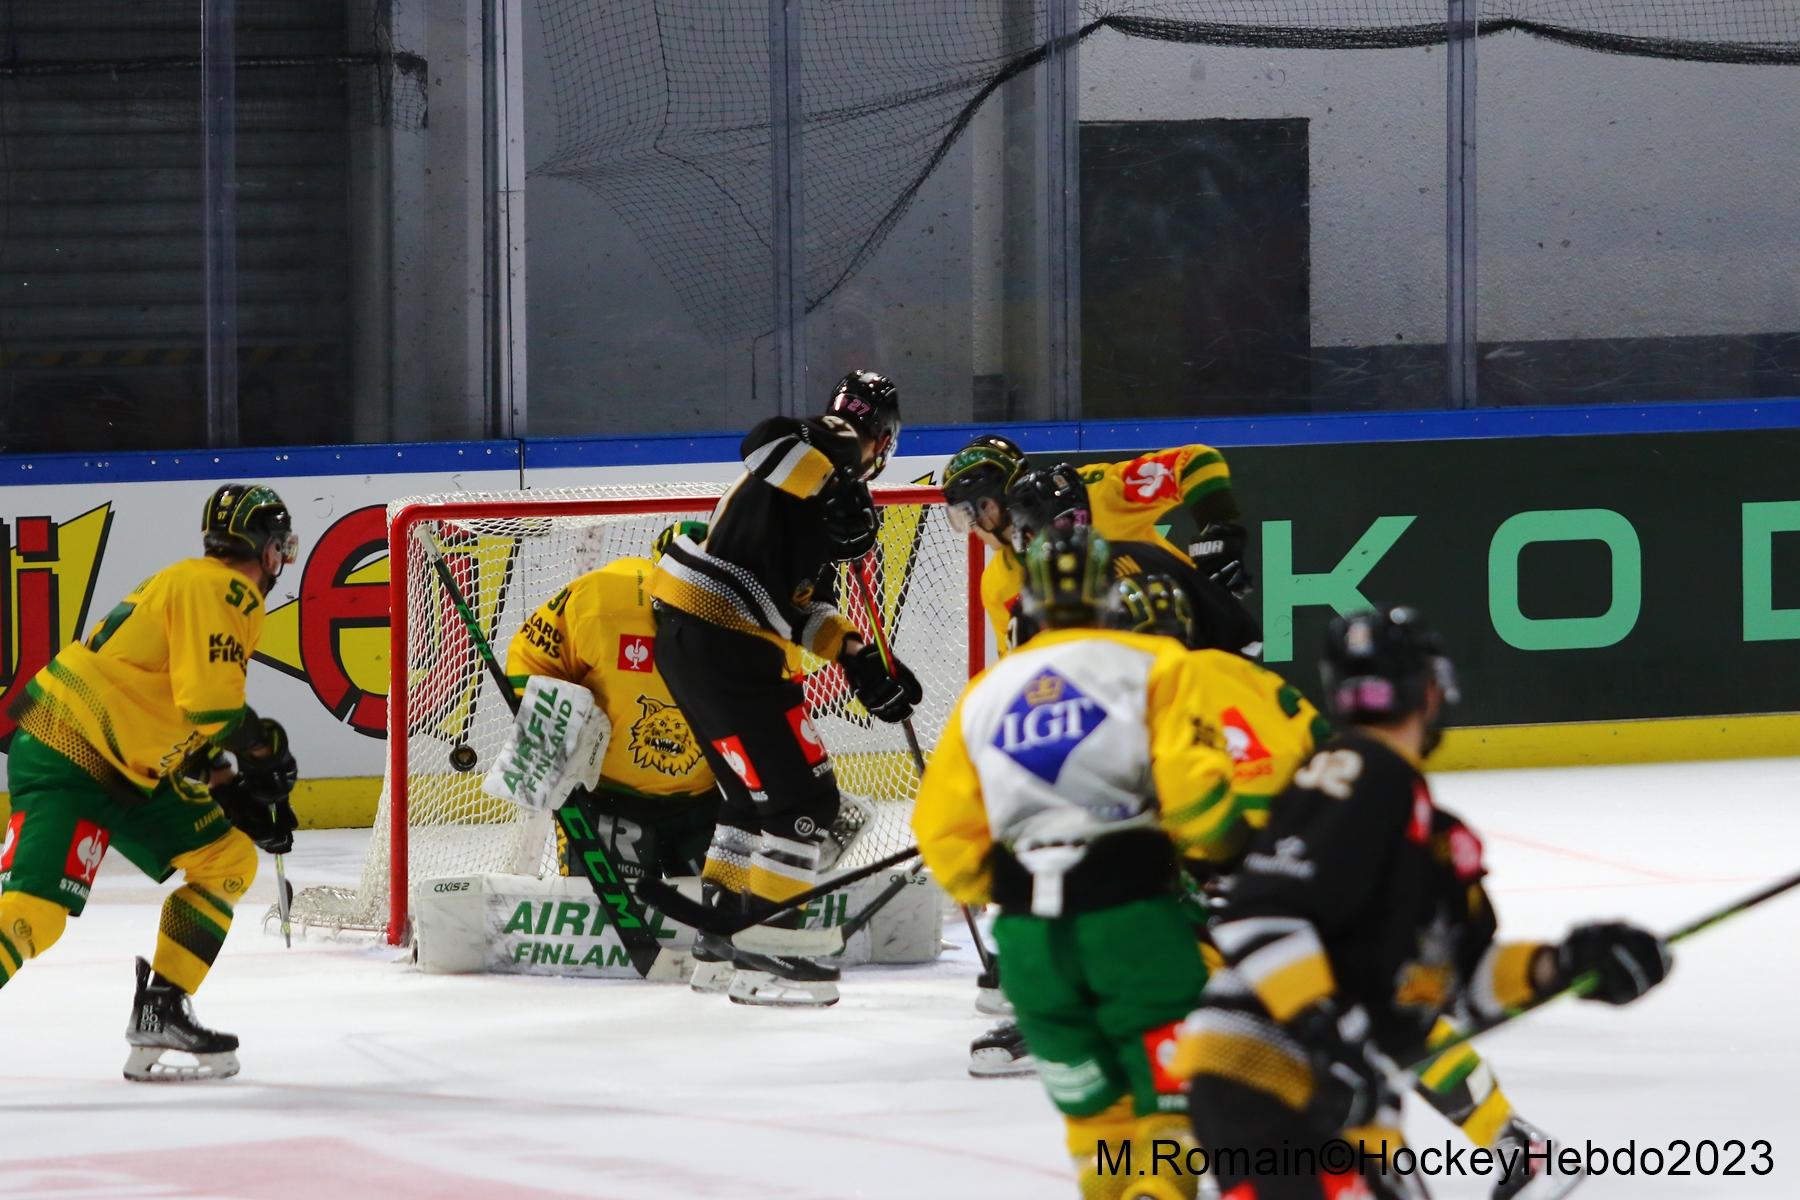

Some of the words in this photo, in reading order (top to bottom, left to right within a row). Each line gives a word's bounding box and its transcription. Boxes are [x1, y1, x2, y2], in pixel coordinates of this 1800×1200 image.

[225, 577, 260, 616] 57
[1154, 500, 1800, 662] KO
[520, 623, 561, 659] FILMS
[1001, 697, 1095, 752] LGT
[796, 893, 853, 929] FIL
[513, 942, 634, 969] FINLAN
